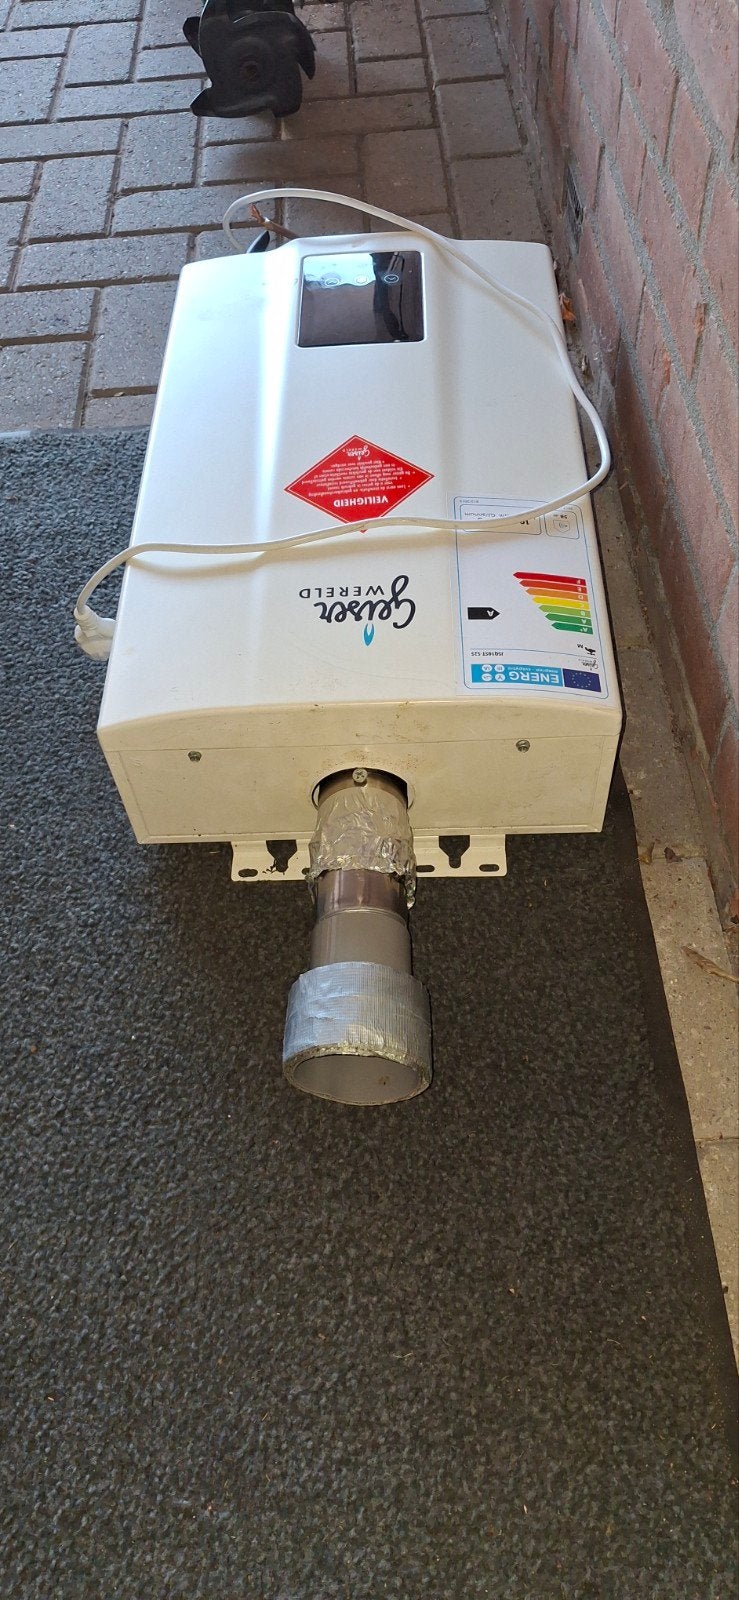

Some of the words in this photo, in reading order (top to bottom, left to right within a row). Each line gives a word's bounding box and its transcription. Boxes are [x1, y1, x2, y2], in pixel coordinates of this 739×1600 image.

[333, 495, 388, 508] VEILIGHEID
[299, 585, 384, 598] WERELD
[314, 575, 416, 629] Geiser
[509, 671, 559, 684] ENERG
